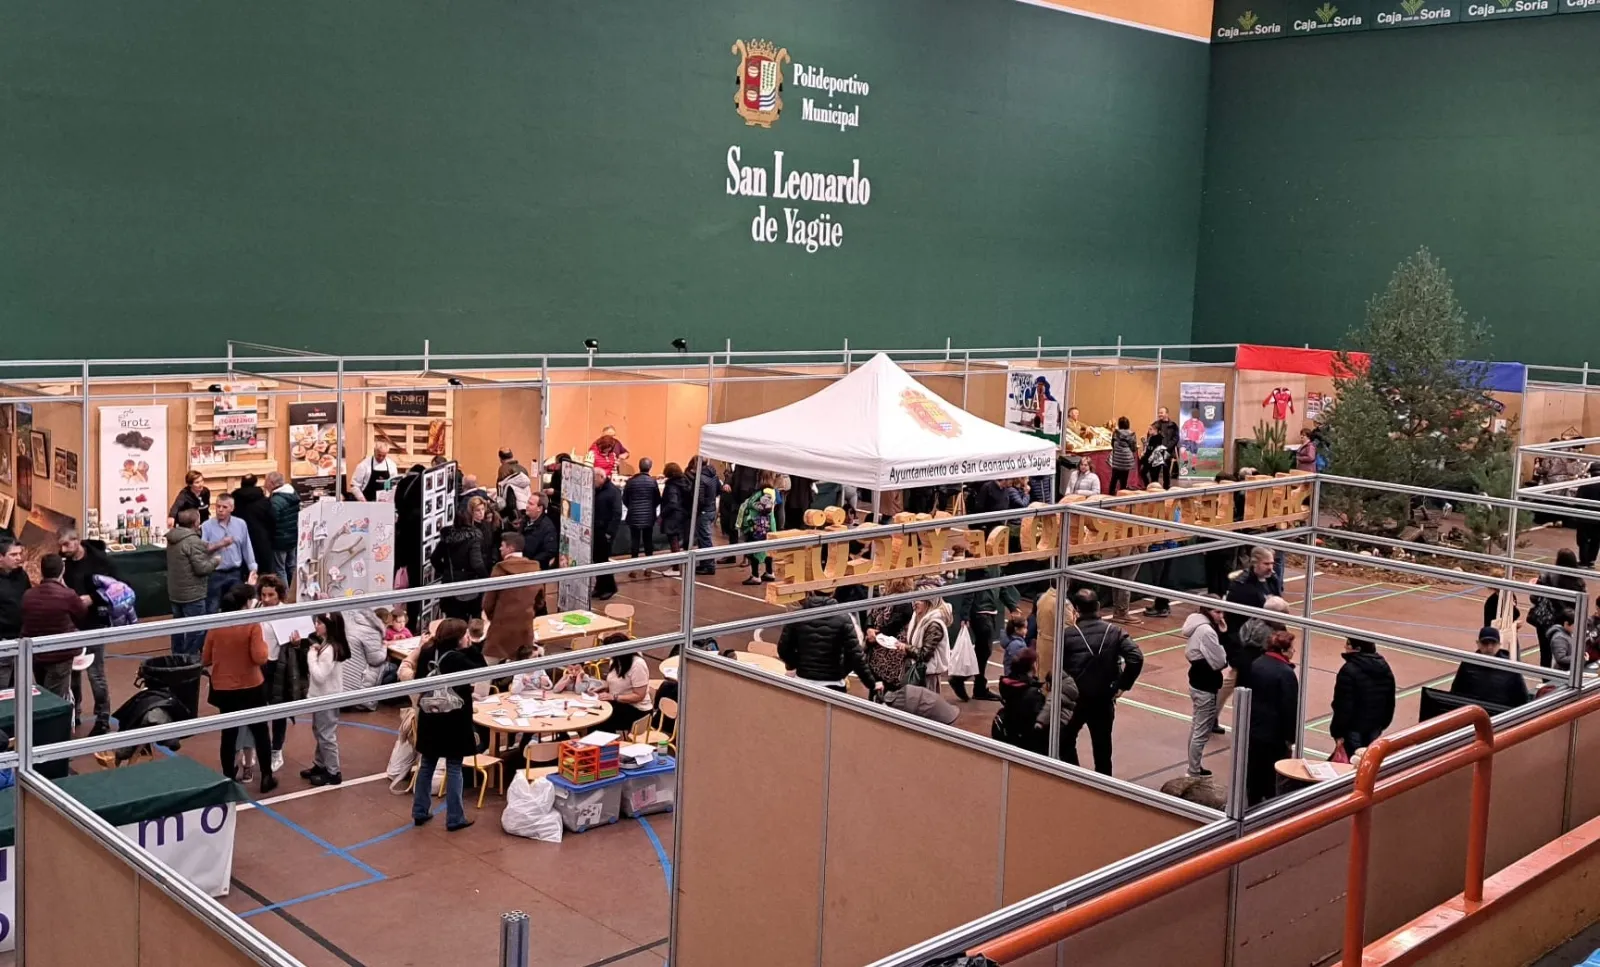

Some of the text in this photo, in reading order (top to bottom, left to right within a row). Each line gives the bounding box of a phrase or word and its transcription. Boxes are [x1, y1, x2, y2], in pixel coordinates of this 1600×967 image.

[1377, 8, 1451, 25] Caja Soria
[1468, 0, 1548, 17] Caja Soria
[1217, 23, 1281, 39] Caja Soria
[1294, 15, 1362, 33] Caja Soria
[792, 63, 869, 97] Polideportivo
[802, 98, 859, 132] Municipal
[727, 145, 871, 205] San Leonardo
[751, 206, 843, 253] de Yagüe
[120, 417, 151, 428] arotz
[889, 453, 1051, 484] Ayuntamiento de San Leonardo de Yagüe
